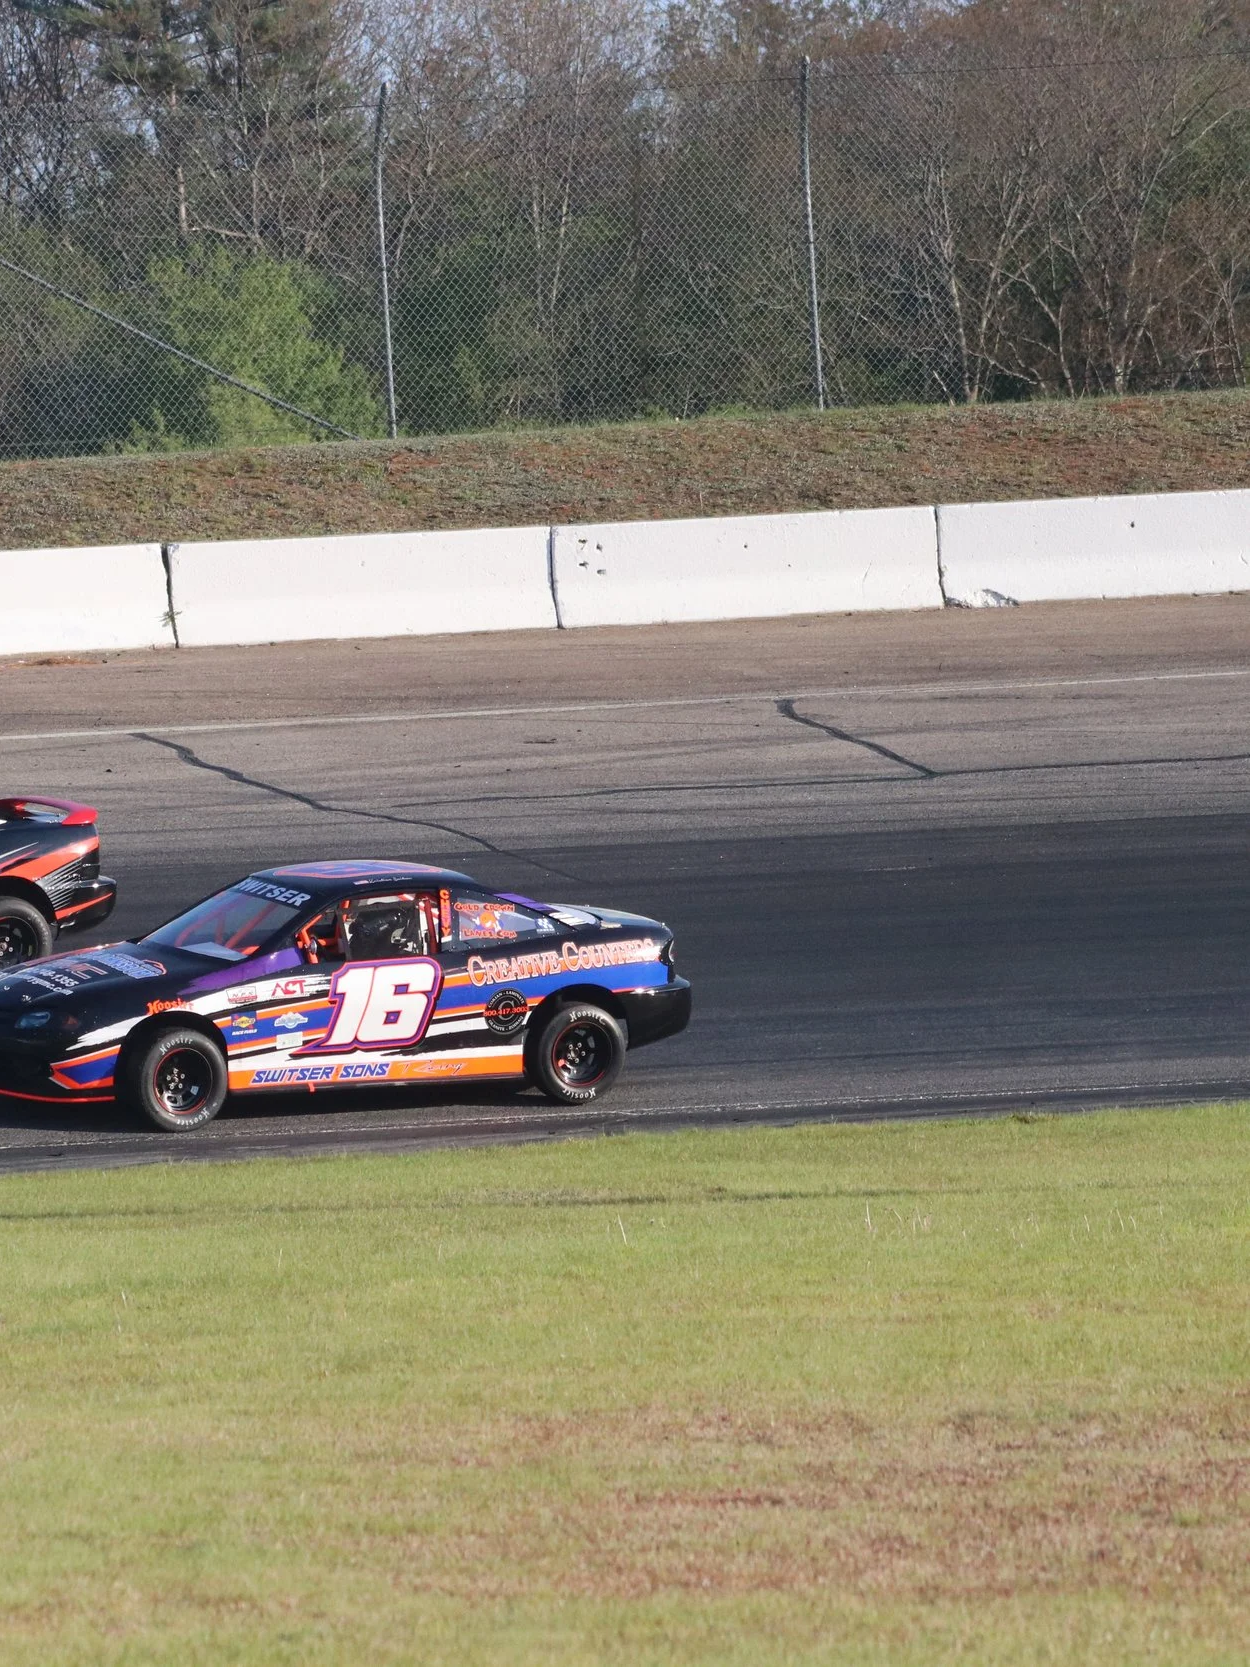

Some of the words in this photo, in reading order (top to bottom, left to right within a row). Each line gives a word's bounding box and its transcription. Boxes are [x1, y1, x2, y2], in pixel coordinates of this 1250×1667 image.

[236, 879, 311, 907] SWITSER
[271, 980, 306, 997] ACT
[146, 998, 194, 1015] Hoosier
[317, 961, 438, 1048] 16
[569, 1010, 606, 1026] Hoosier
[159, 1035, 193, 1056] Hoosier
[251, 1066, 335, 1084] SWITSER
[339, 1062, 390, 1079] SONS
[562, 1087, 596, 1099] Hoosier
[176, 1107, 210, 1129] Hoosier
